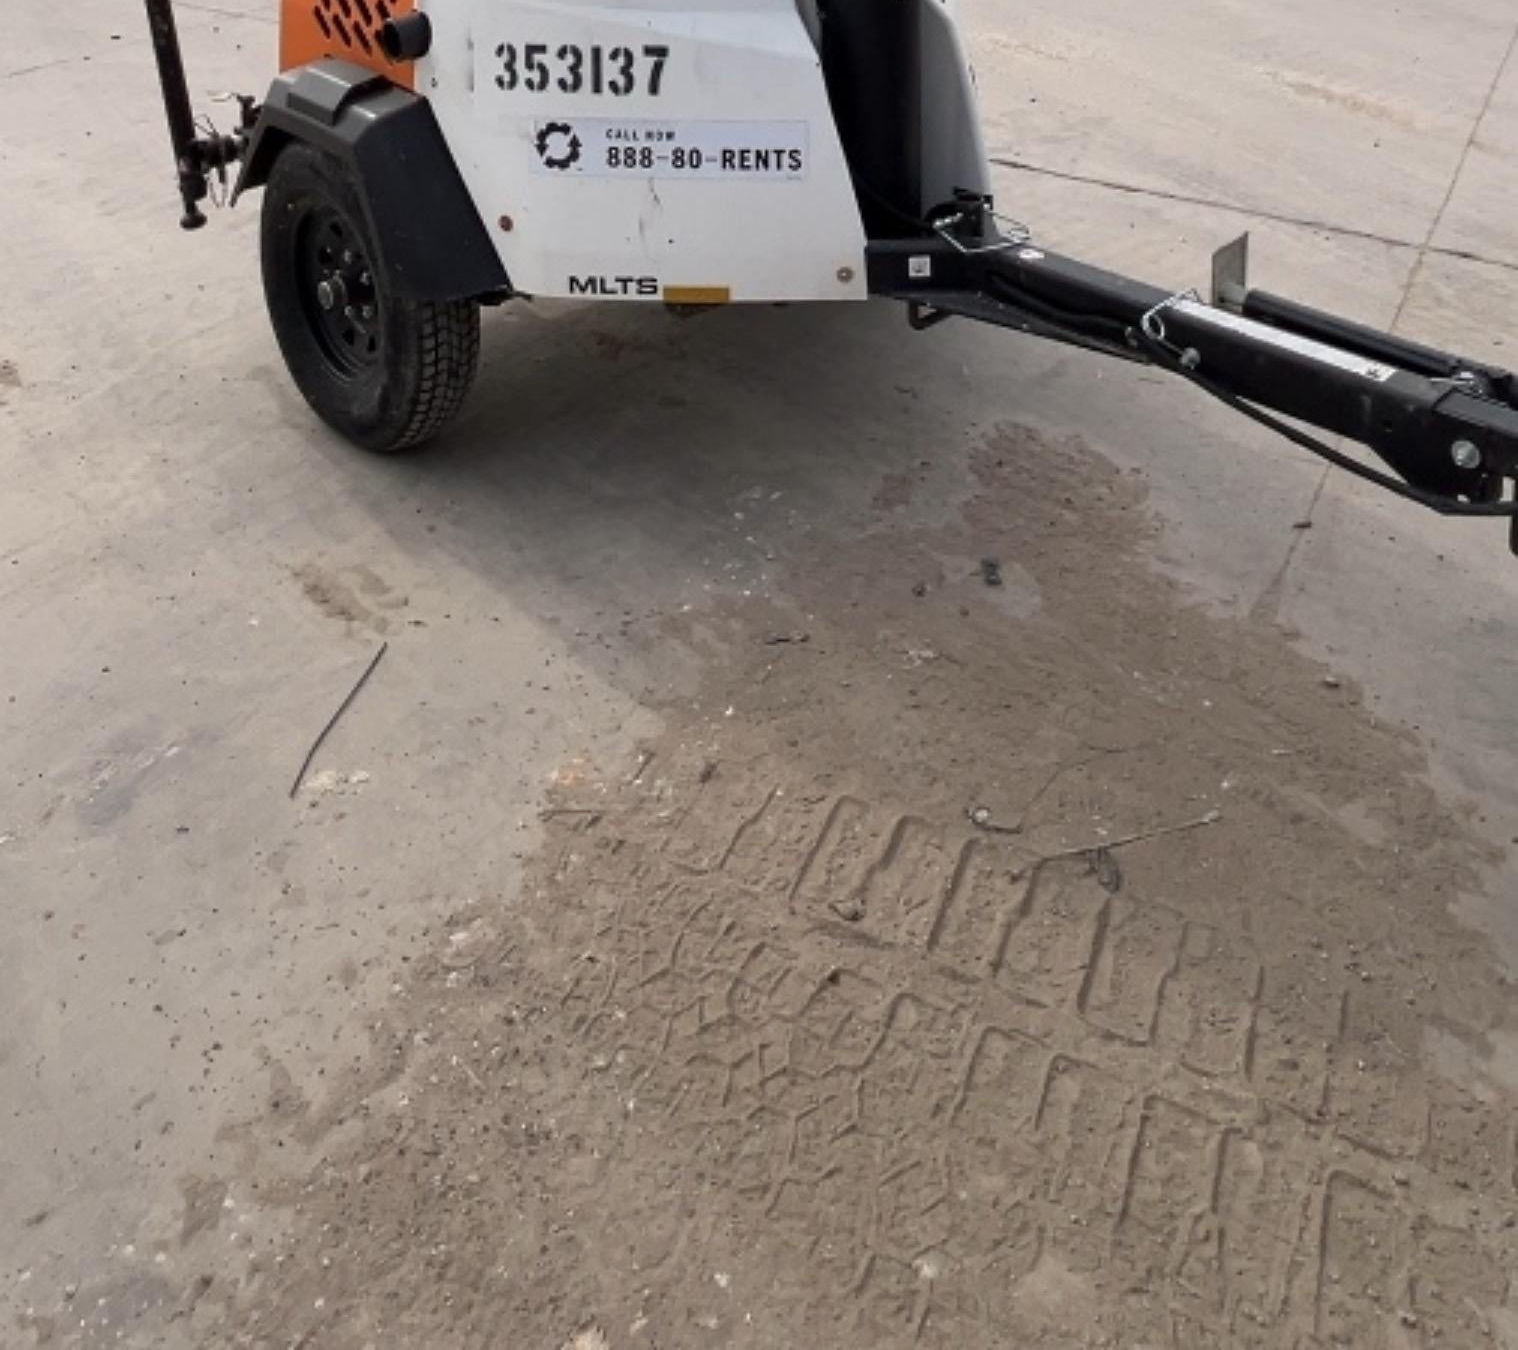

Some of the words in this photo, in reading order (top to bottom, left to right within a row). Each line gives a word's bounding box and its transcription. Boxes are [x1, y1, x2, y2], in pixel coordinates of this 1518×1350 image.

[494, 42, 670, 97] 353137
[605, 129, 639, 141] CALL
[645, 131, 676, 142] NOW
[606, 146, 802, 171] 888-80-RENTS
[568, 275, 658, 295] MLTS
